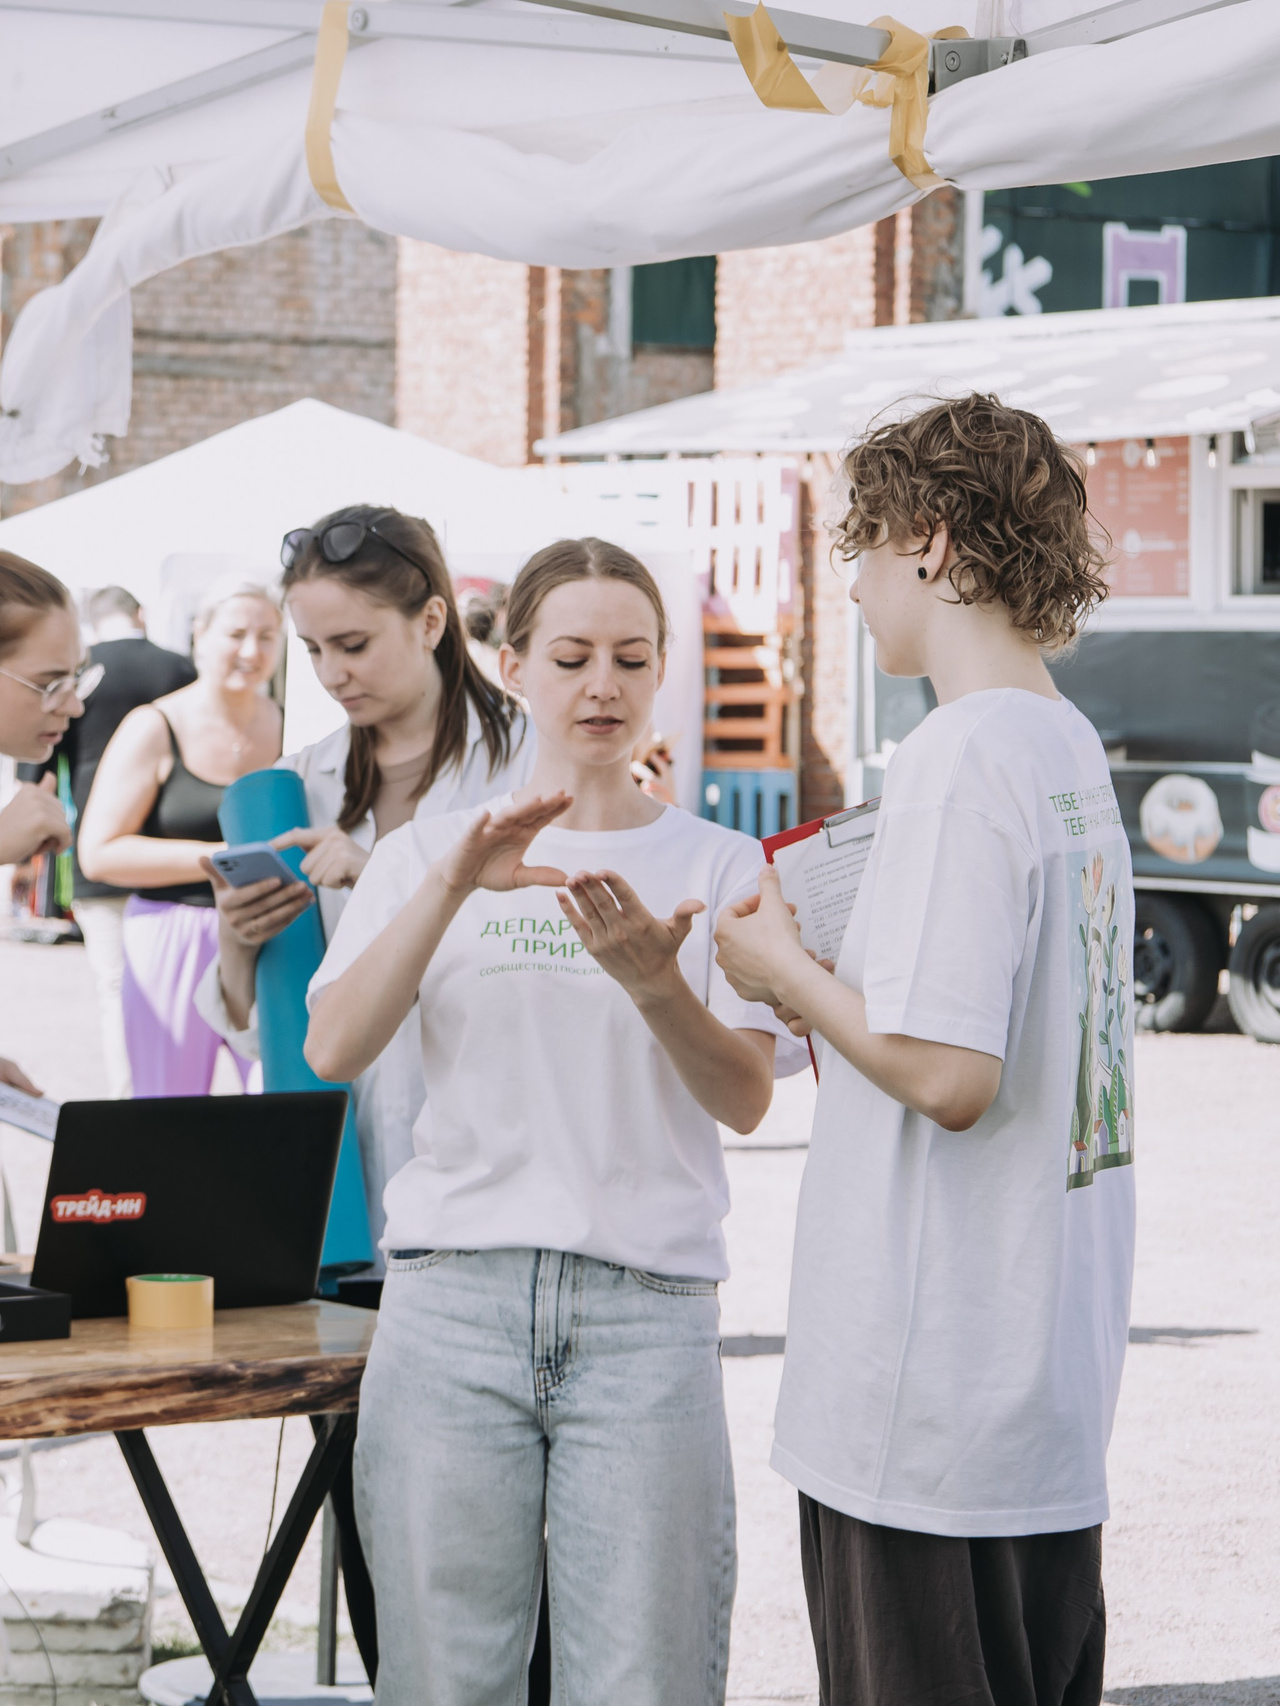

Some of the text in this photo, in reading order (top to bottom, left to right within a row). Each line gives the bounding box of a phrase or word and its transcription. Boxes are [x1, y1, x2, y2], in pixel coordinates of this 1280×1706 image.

[1049, 791, 1079, 813] ТЕБЕ
[480, 962, 553, 977] СООБЩЕСТВО
[55, 1195, 142, 1218] ТРЕЙД-ИН
